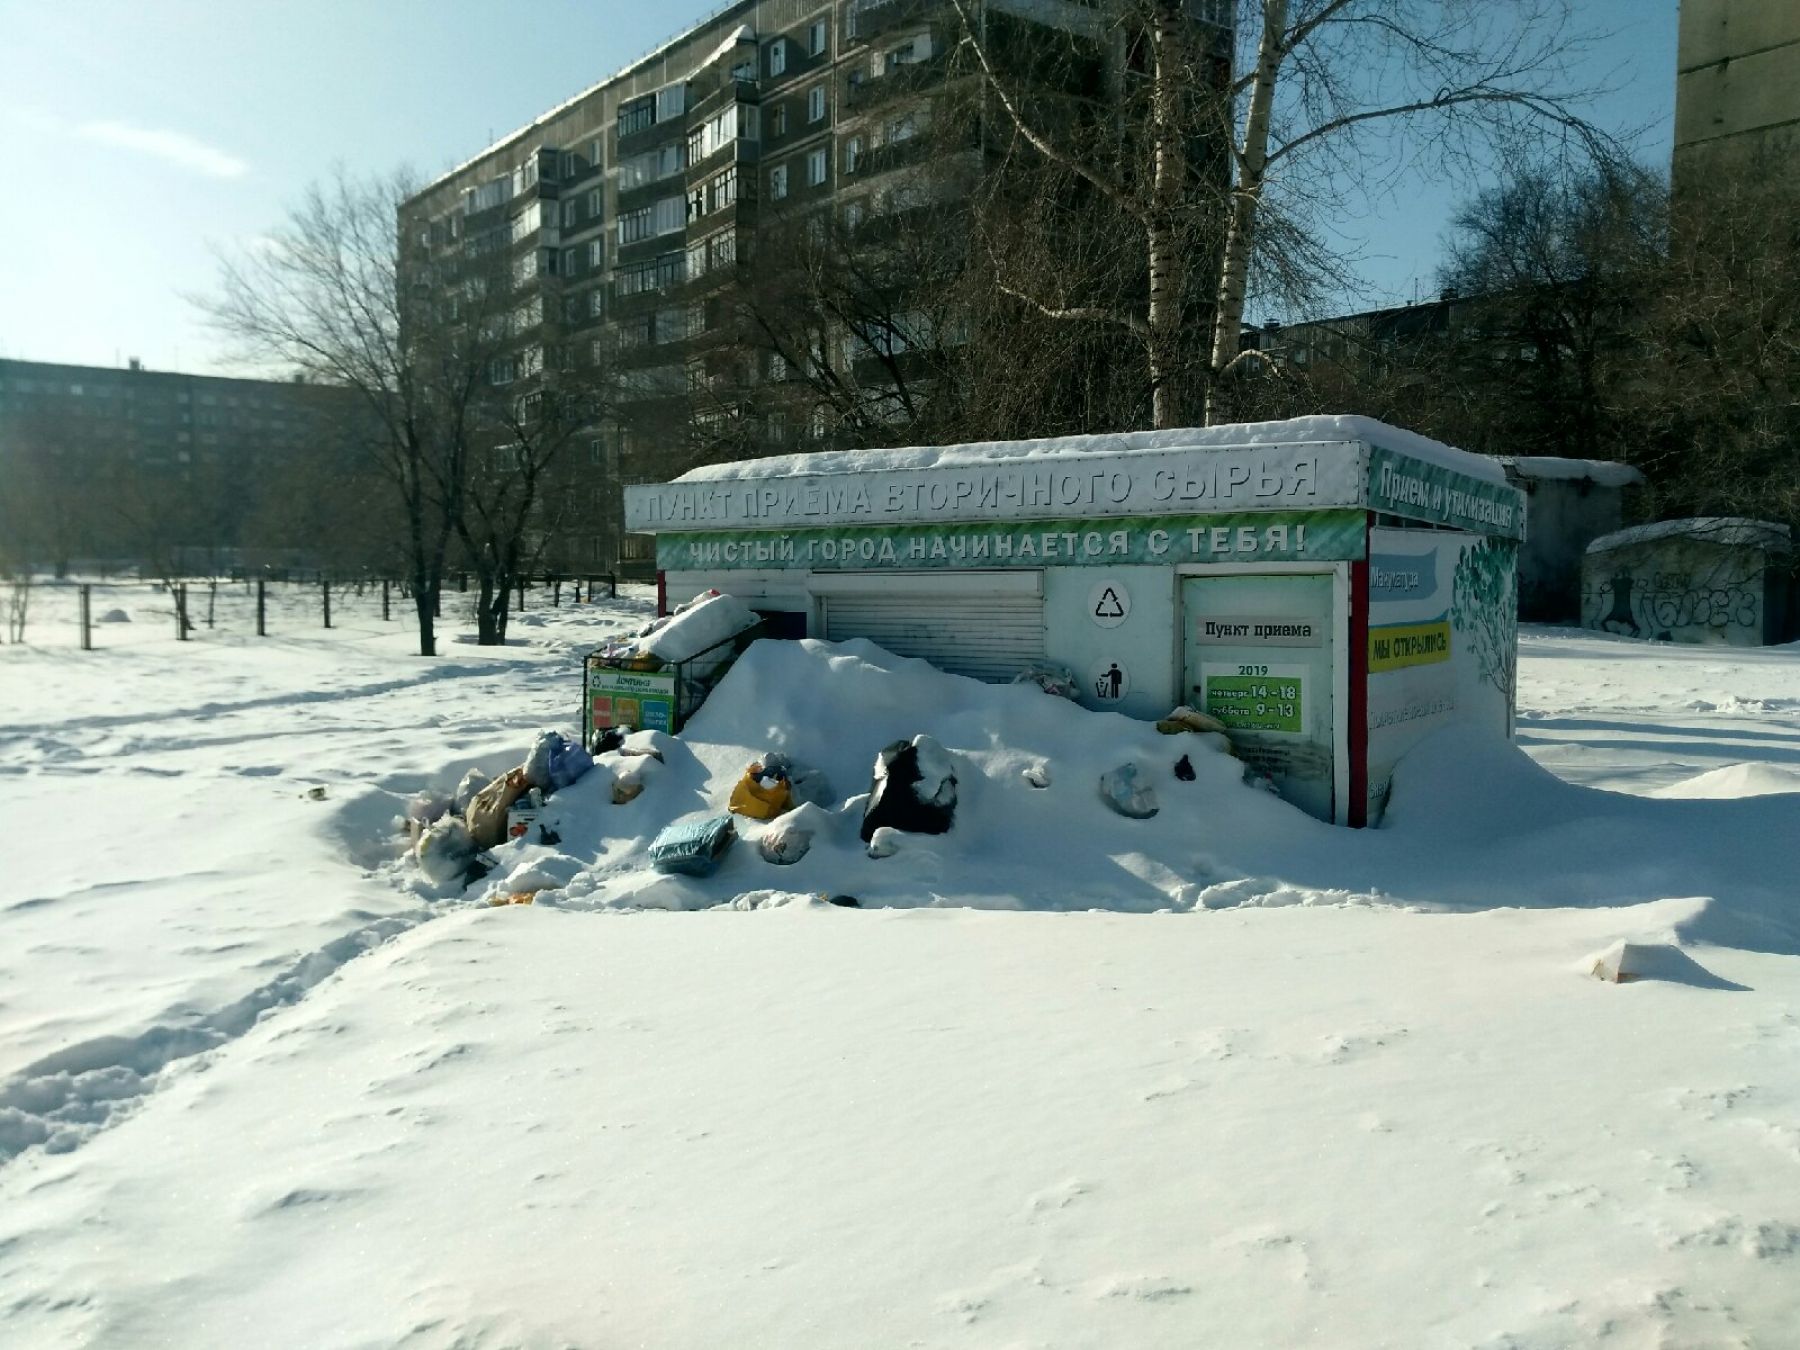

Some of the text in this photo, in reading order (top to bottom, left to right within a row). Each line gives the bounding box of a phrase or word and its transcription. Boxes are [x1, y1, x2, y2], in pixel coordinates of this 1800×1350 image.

[646, 489, 732, 521] ПУНКТ
[885, 469, 1132, 512] ВТОРИЧНОГО
[1151, 458, 1318, 501] СЫРЬЯ
[1380, 460, 1513, 529] Прием и утилизация
[689, 524, 1306, 564] ЧИСТЫЙ ГОРОД НАЧИНАЕТСЯ С ТЕБЯ!
[1205, 621, 1312, 639] Пункт приема
[1373, 632, 1448, 661] МЫ ОТКРЫЛИСЬ
[1238, 665, 1269, 676] 2019
[1251, 685, 1267, 698] 14
[1280, 686, 1296, 700] 18
[1256, 704, 1266, 716] 9
[1277, 704, 1294, 717] 13
